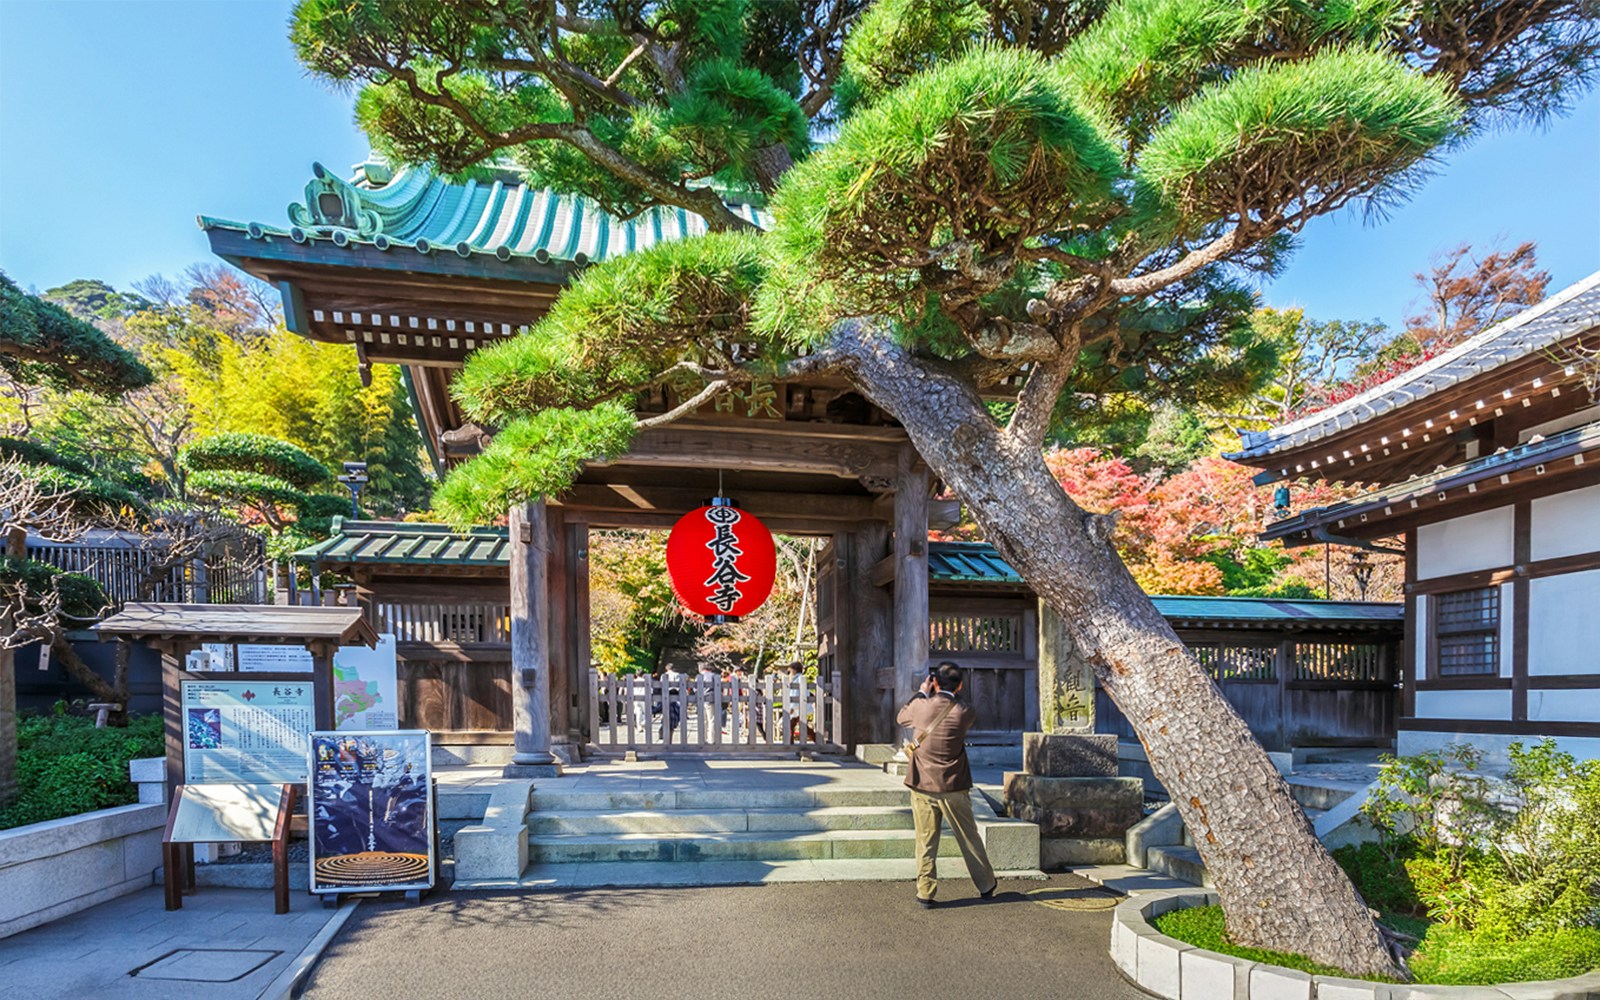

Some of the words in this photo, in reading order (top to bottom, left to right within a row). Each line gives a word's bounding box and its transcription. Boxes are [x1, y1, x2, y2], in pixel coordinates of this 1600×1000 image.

[706, 524, 751, 612] 長谷寺
[272, 687, 304, 696] 長谷寺
